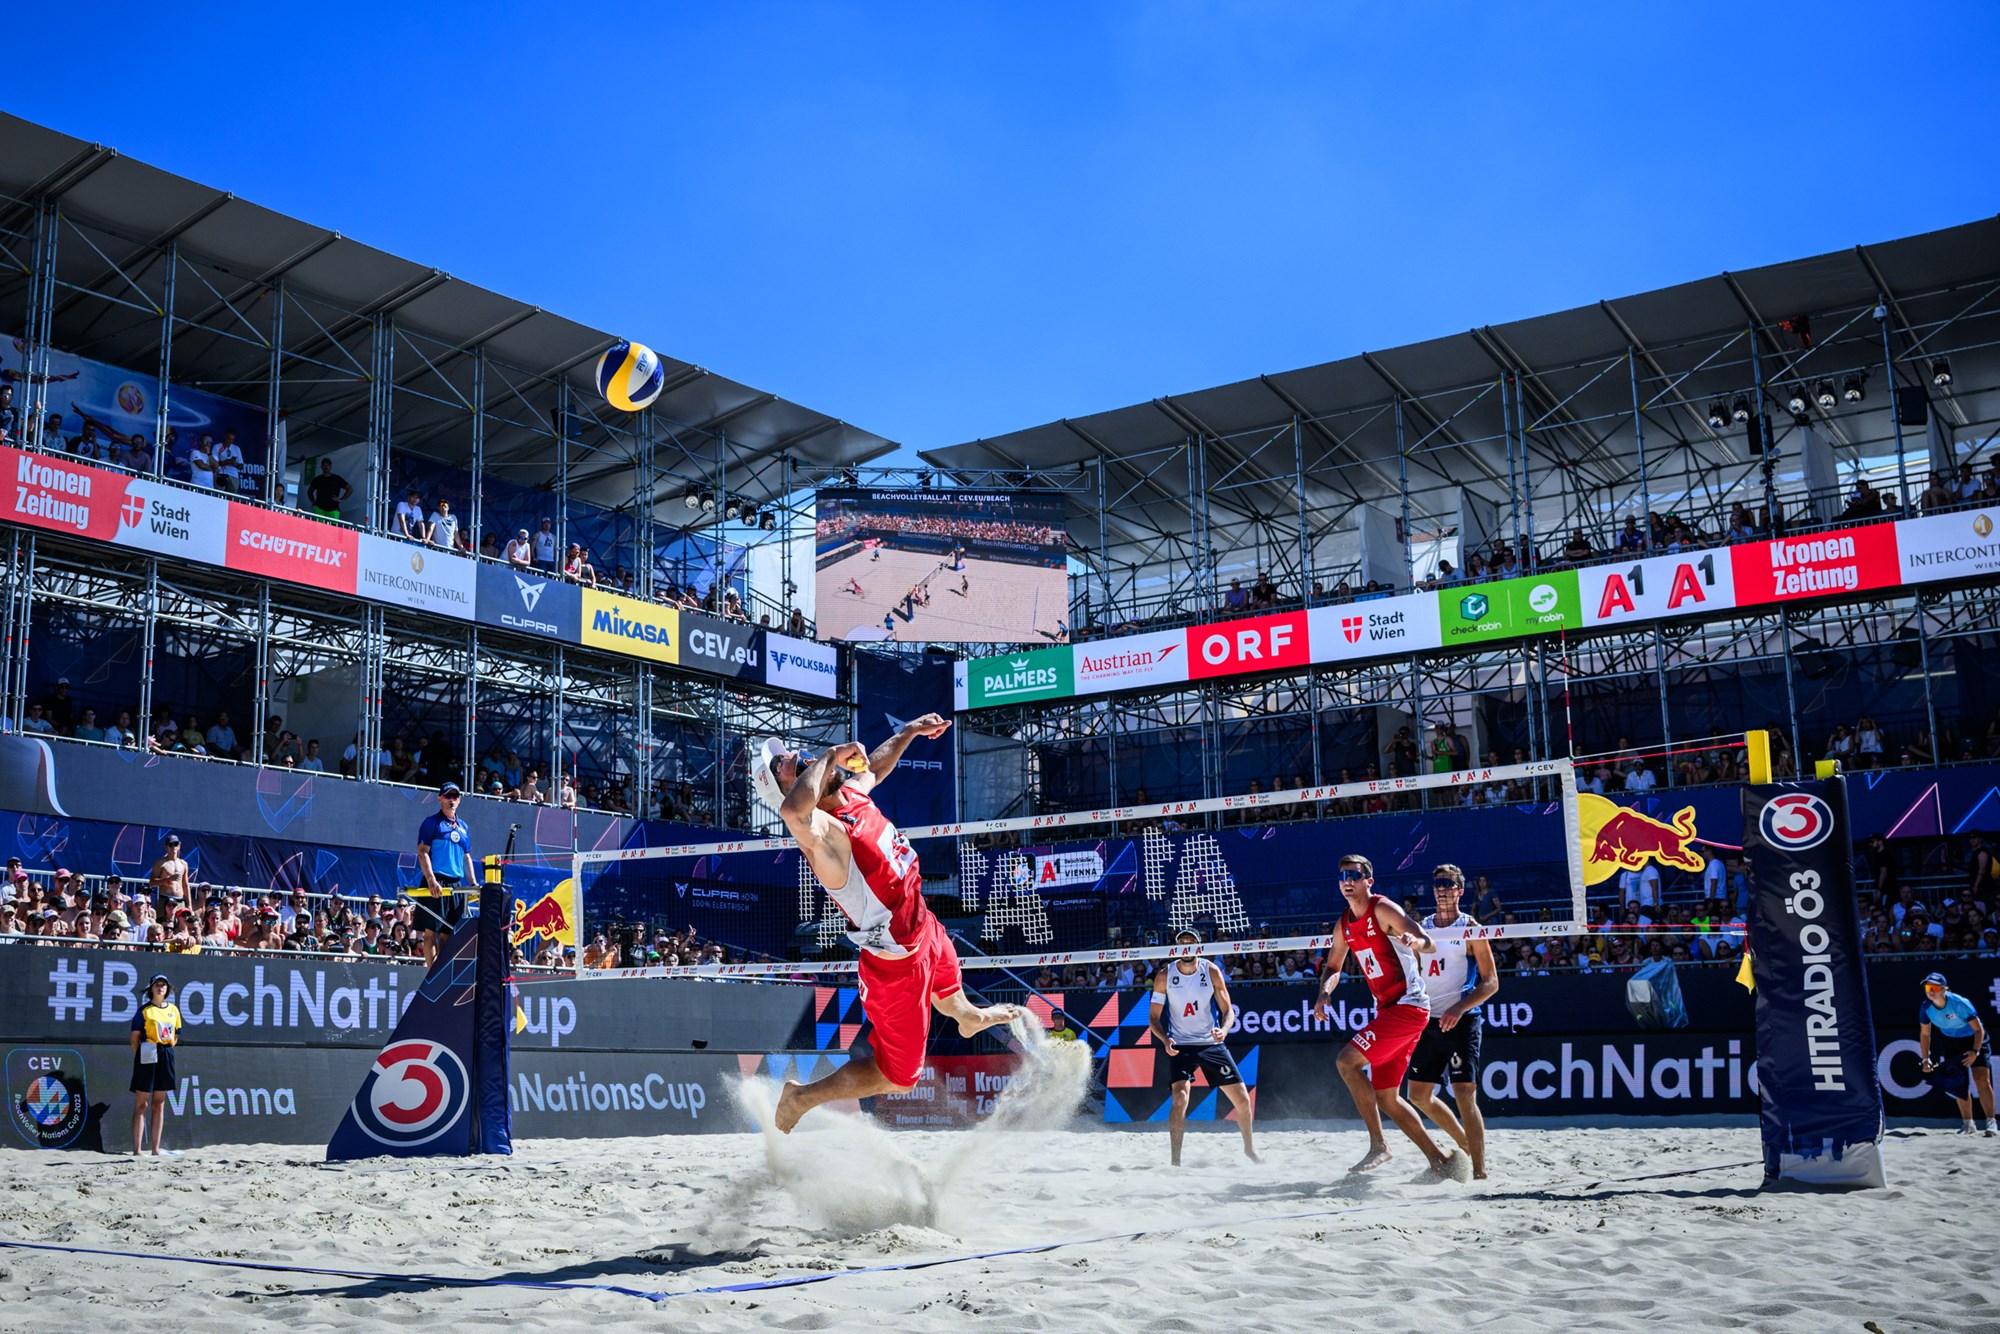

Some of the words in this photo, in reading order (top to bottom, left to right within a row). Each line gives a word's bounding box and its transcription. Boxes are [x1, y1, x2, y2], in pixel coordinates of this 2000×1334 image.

[17, 455, 91, 498] Kronen
[239, 463, 265, 475] rone
[872, 493, 951, 502] BEACHVOLLEYBALL.AT
[958, 494, 1010, 502] CEV.EU/BEACH
[14, 486, 90, 530] Zeitung
[151, 500, 190, 522] Stadt
[150, 520, 190, 541] Wien
[972, 539, 1039, 552] #BeachNationsCup
[1770, 535, 1856, 568] Kronen
[1597, 564, 1644, 618] A1
[1667, 553, 1714, 610] A1
[1772, 564, 1858, 596] Zeitung
[407, 596, 425, 605] WIEN
[501, 614, 558, 634] CUPRA
[1368, 611, 1404, 628] Stadt
[1451, 620, 1502, 636] checkrobin
[1526, 612, 1564, 625] myrobin
[1369, 626, 1405, 641] Wien
[689, 628, 758, 667] CEV.eu
[1202, 624, 1294, 666] ORF
[1080, 650, 1152, 674] Austrian
[956, 678, 964, 688] K
[984, 667, 1057, 692] PALMERS
[898, 759, 942, 770] PRA
[1538, 764, 1554, 772] CEV
[1451, 772, 1460, 784] A1
[1466, 770, 1476, 782] A1
[1482, 769, 1491, 780] A1
[1300, 789, 1309, 800] A1
[1315, 788, 1324, 798] A1
[1329, 786, 1338, 797] A1
[1162, 804, 1170, 814] A1
[1175, 803, 1183, 813] A1
[1188, 802, 1197, 811] A1
[1034, 817, 1041, 826] A1
[1046, 816, 1054, 825] A1
[1058, 815, 1066, 824] A1
[931, 826, 939, 835] A1
[943, 825, 950, 834] A1
[954, 825, 961, 834] A1
[1040, 858, 1060, 884] A1
[1065, 868, 1097, 877] VIENNA
[692, 888, 739, 900] CUPRA
[1784, 870, 1825, 919] Ö3
[1366, 917, 1373, 930] 2
[1463, 929, 1472, 939] A1
[1478, 928, 1488, 938] A1
[1494, 927, 1504, 937] A1
[1310, 938, 1319, 947] A1
[1169, 947, 1177, 956] A1
[1182, 946, 1190, 955] A1
[1195, 946, 1204, 954] A1
[1038, 955, 1047, 964] A1
[1051, 955, 1059, 963] A1
[1063, 954, 1072, 962] A1
[1428, 958, 1445, 977] A1
[1200, 973, 1206, 982] 2
[1183, 1000, 1198, 1017] A1
[1799, 924, 1846, 1092] HITRADIO
[28, 1056, 62, 1070] CEV
[166, 1075, 296, 1117] Vienna
[42, 1128, 69, 1139] Nations
[68, 1114, 80, 1129] Cup
